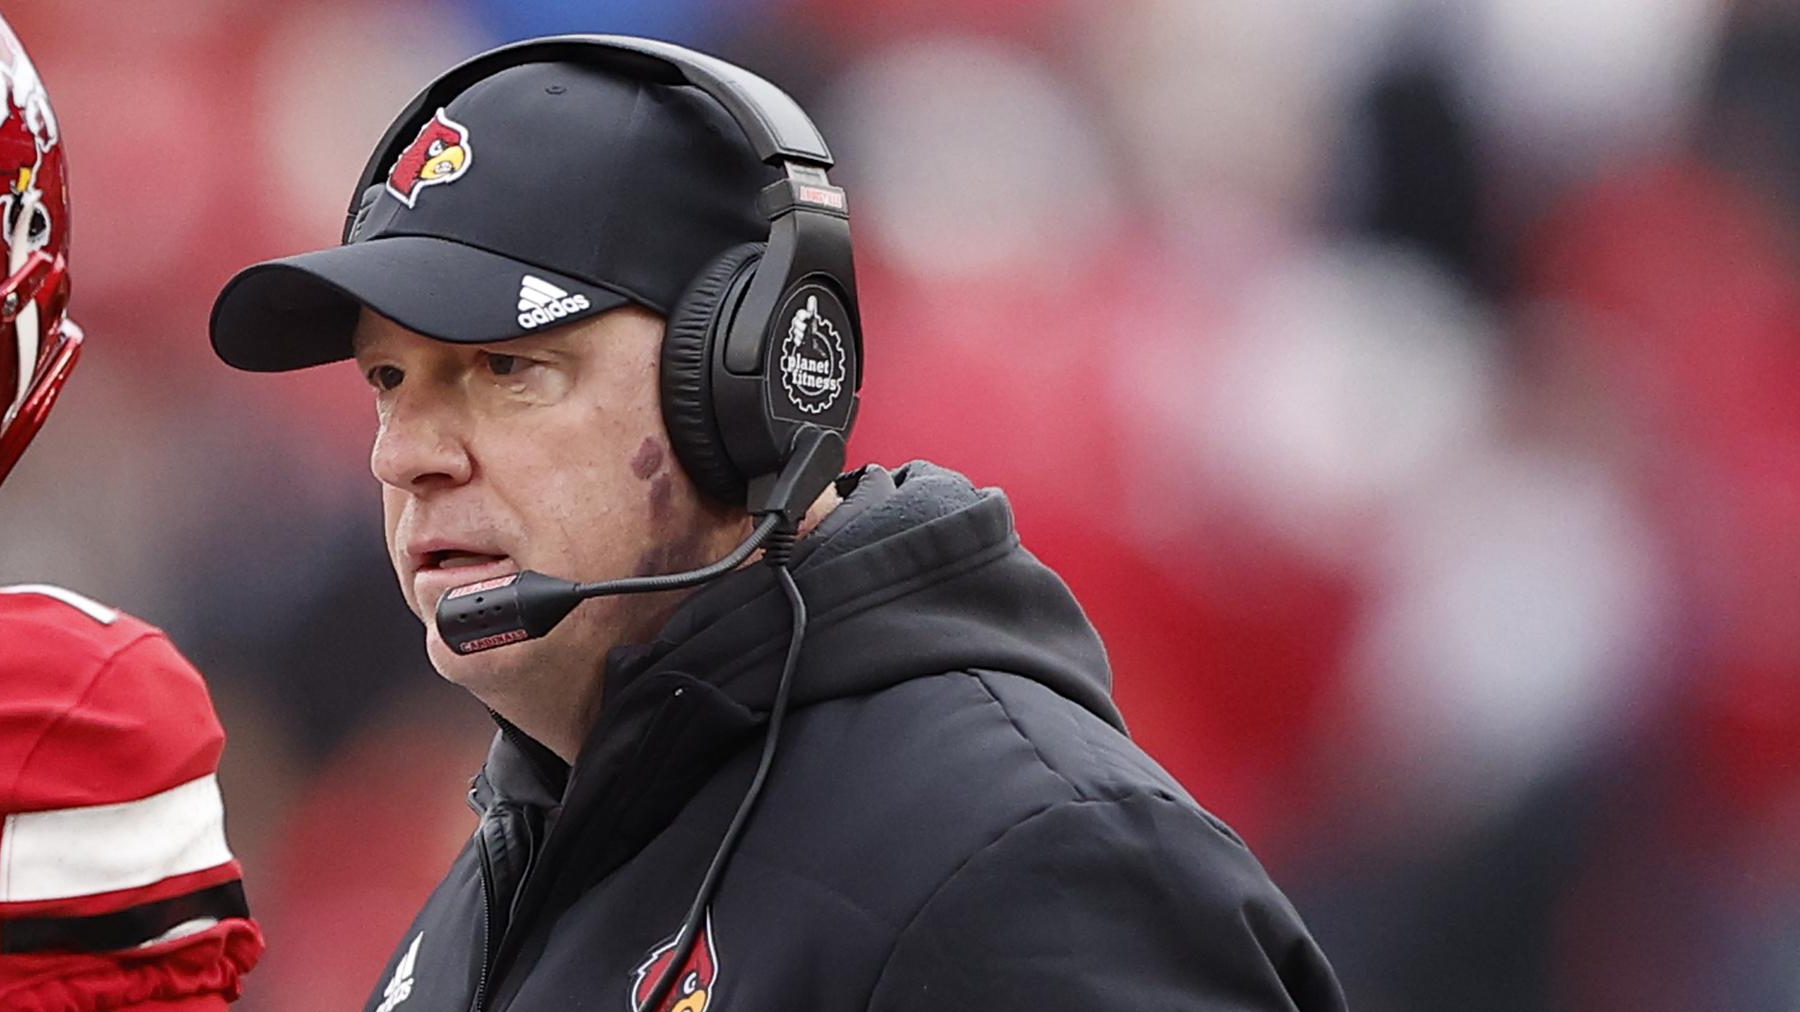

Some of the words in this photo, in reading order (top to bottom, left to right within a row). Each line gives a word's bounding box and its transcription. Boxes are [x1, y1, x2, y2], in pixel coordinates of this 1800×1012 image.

[517, 294, 590, 329] adidas
[787, 353, 830, 374] planet
[792, 369, 837, 390] fitness
[460, 629, 529, 653] CARDINALS
